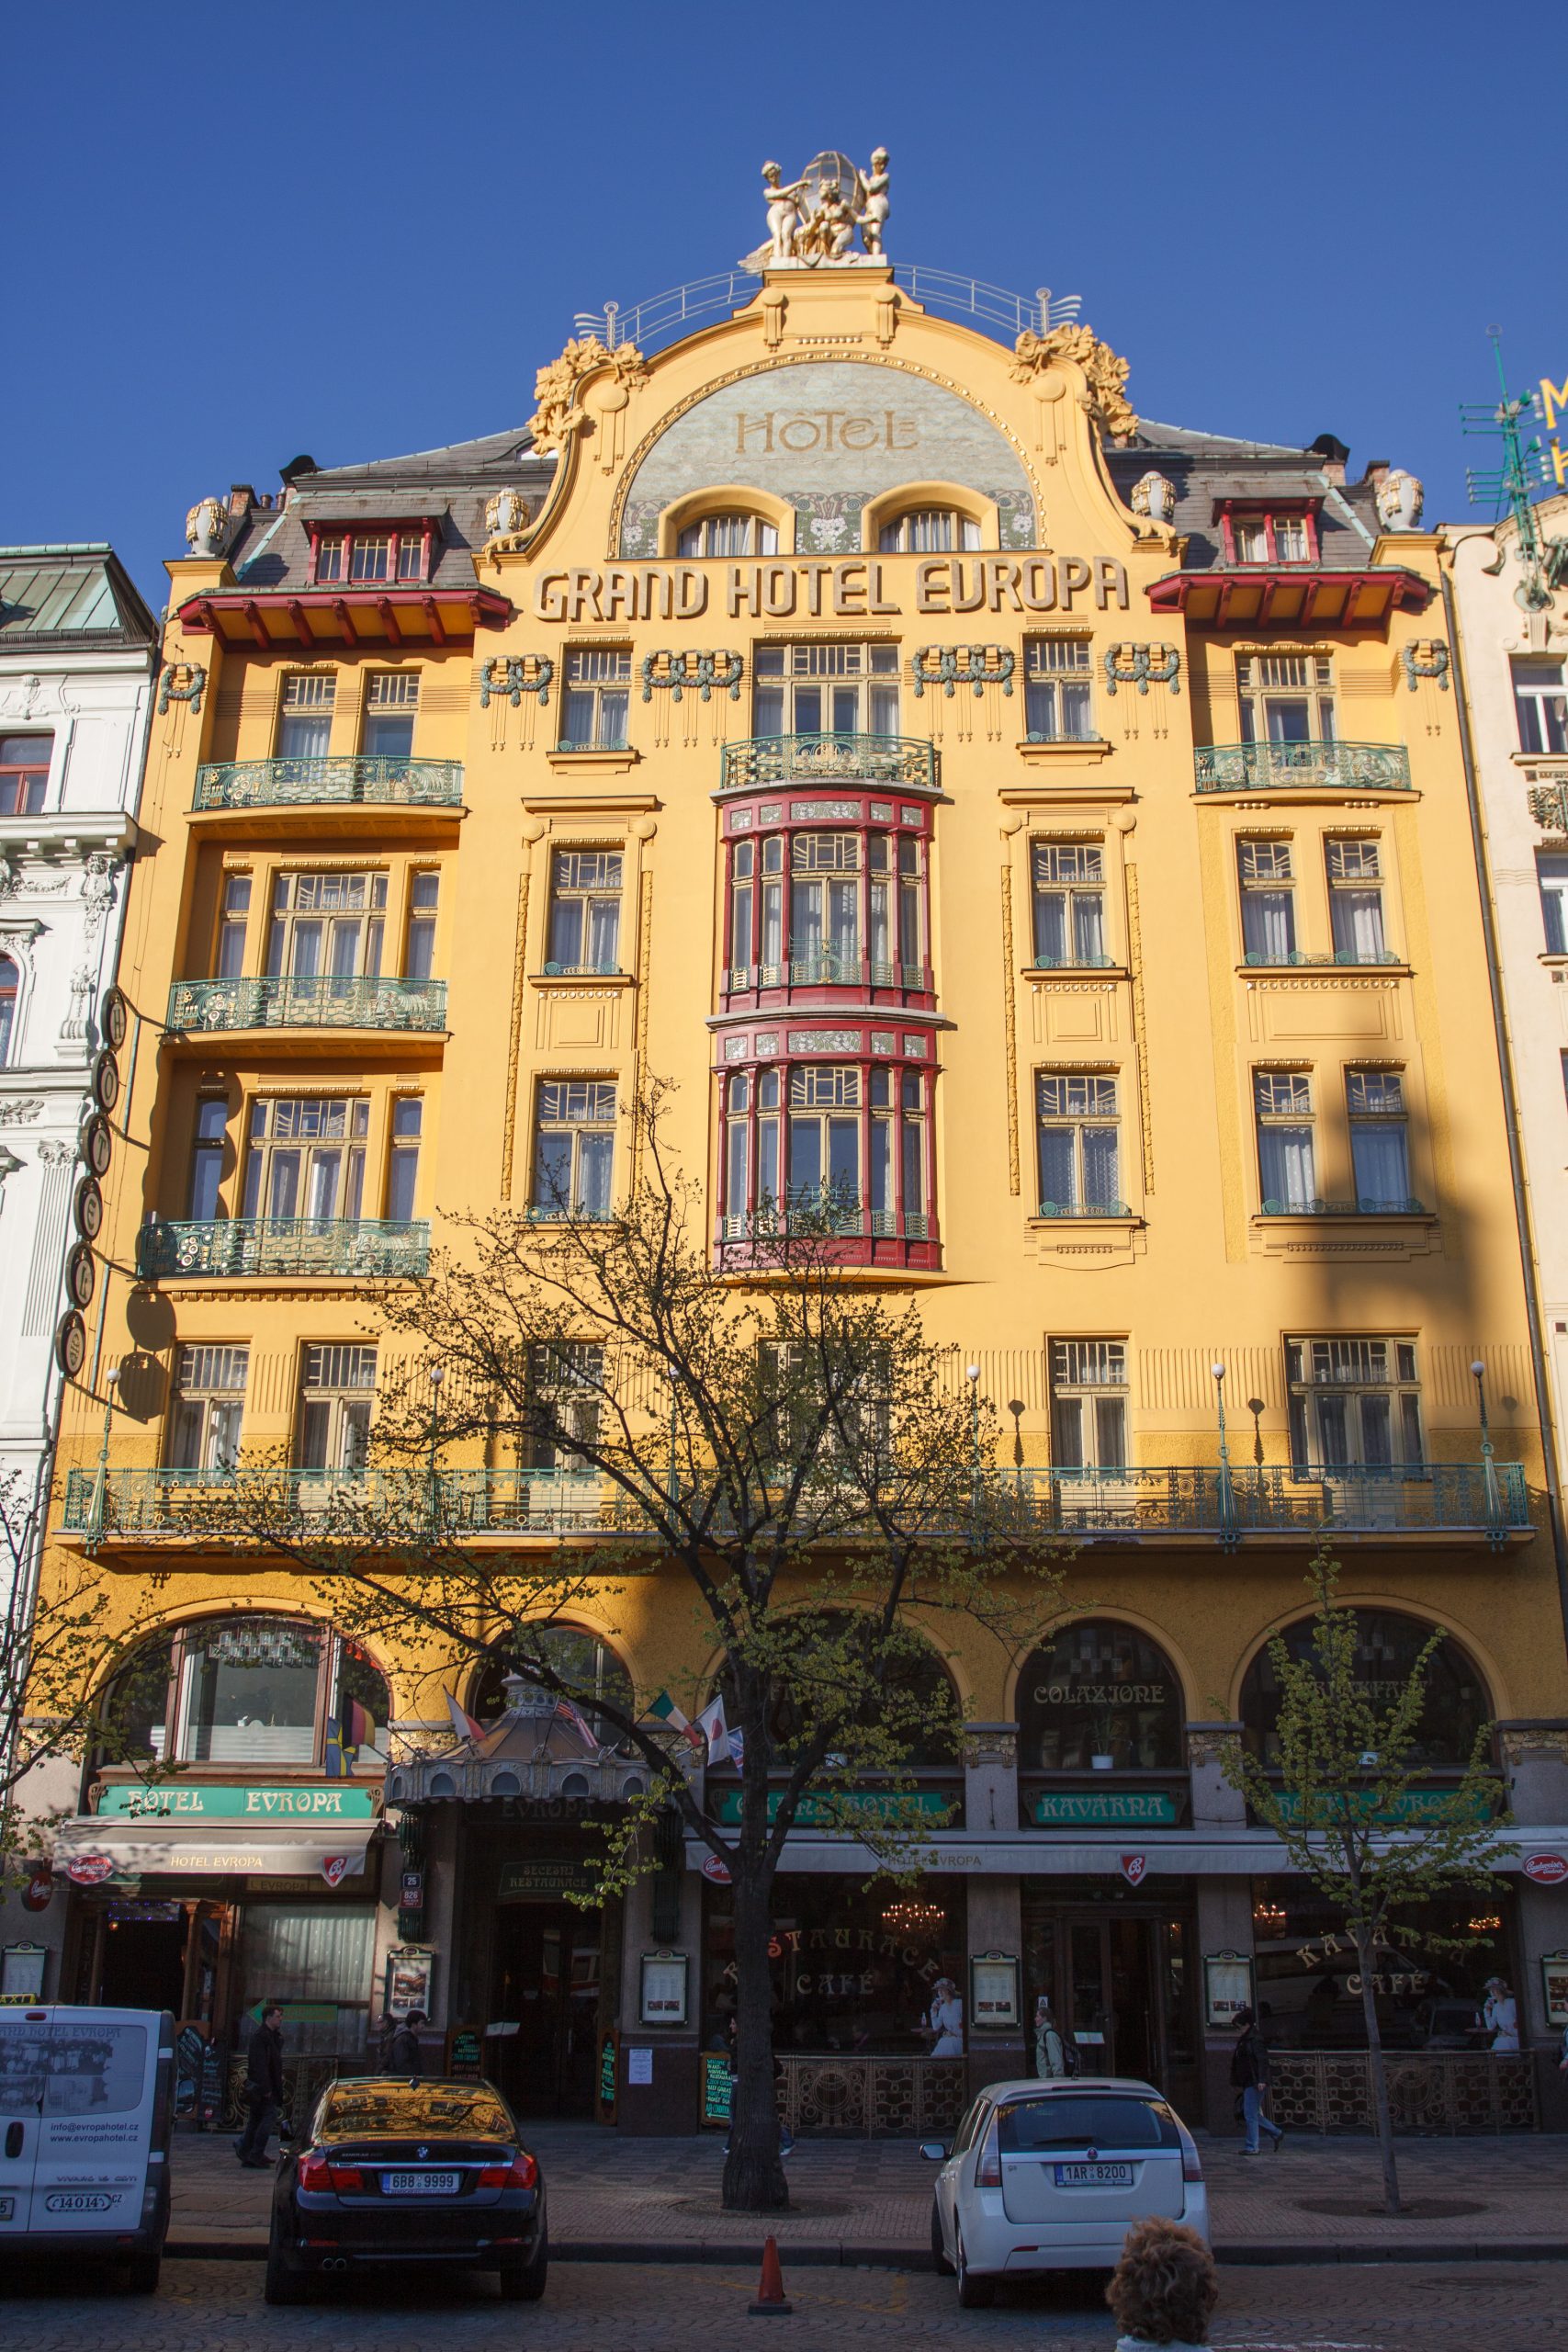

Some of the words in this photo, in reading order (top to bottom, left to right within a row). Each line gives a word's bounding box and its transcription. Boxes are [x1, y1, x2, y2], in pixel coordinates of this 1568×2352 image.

[535, 566, 705, 621] GRAND
[727, 560, 901, 616] HOTEL
[1033, 1685, 1165, 1703] COLAZIONE
[246, 1792, 344, 1813] EVROPA
[1042, 1792, 1165, 1817] KAVÁRNA
[170, 1856, 210, 1867] HOTEL
[212, 1856, 264, 1868] EVROPA
[931, 1856, 982, 1866] VROPA
[407, 1876, 417, 1885] 25
[404, 1891, 418, 1899] 826
[723, 1928, 940, 1984] RSTAURACE
[29, 2027, 69, 2037] HOTEL
[73, 2027, 121, 2038] EVROPA
[51, 2122, 139, 2132] info@evropahotel.cz
[50, 2133, 139, 2143] www.evropahotel.cz
[1066, 2166, 1088, 2179] 1AR
[1097, 2165, 1126, 2178] 8200
[392, 2175, 415, 2188] 6B8
[423, 2175, 454, 2188] 9999
